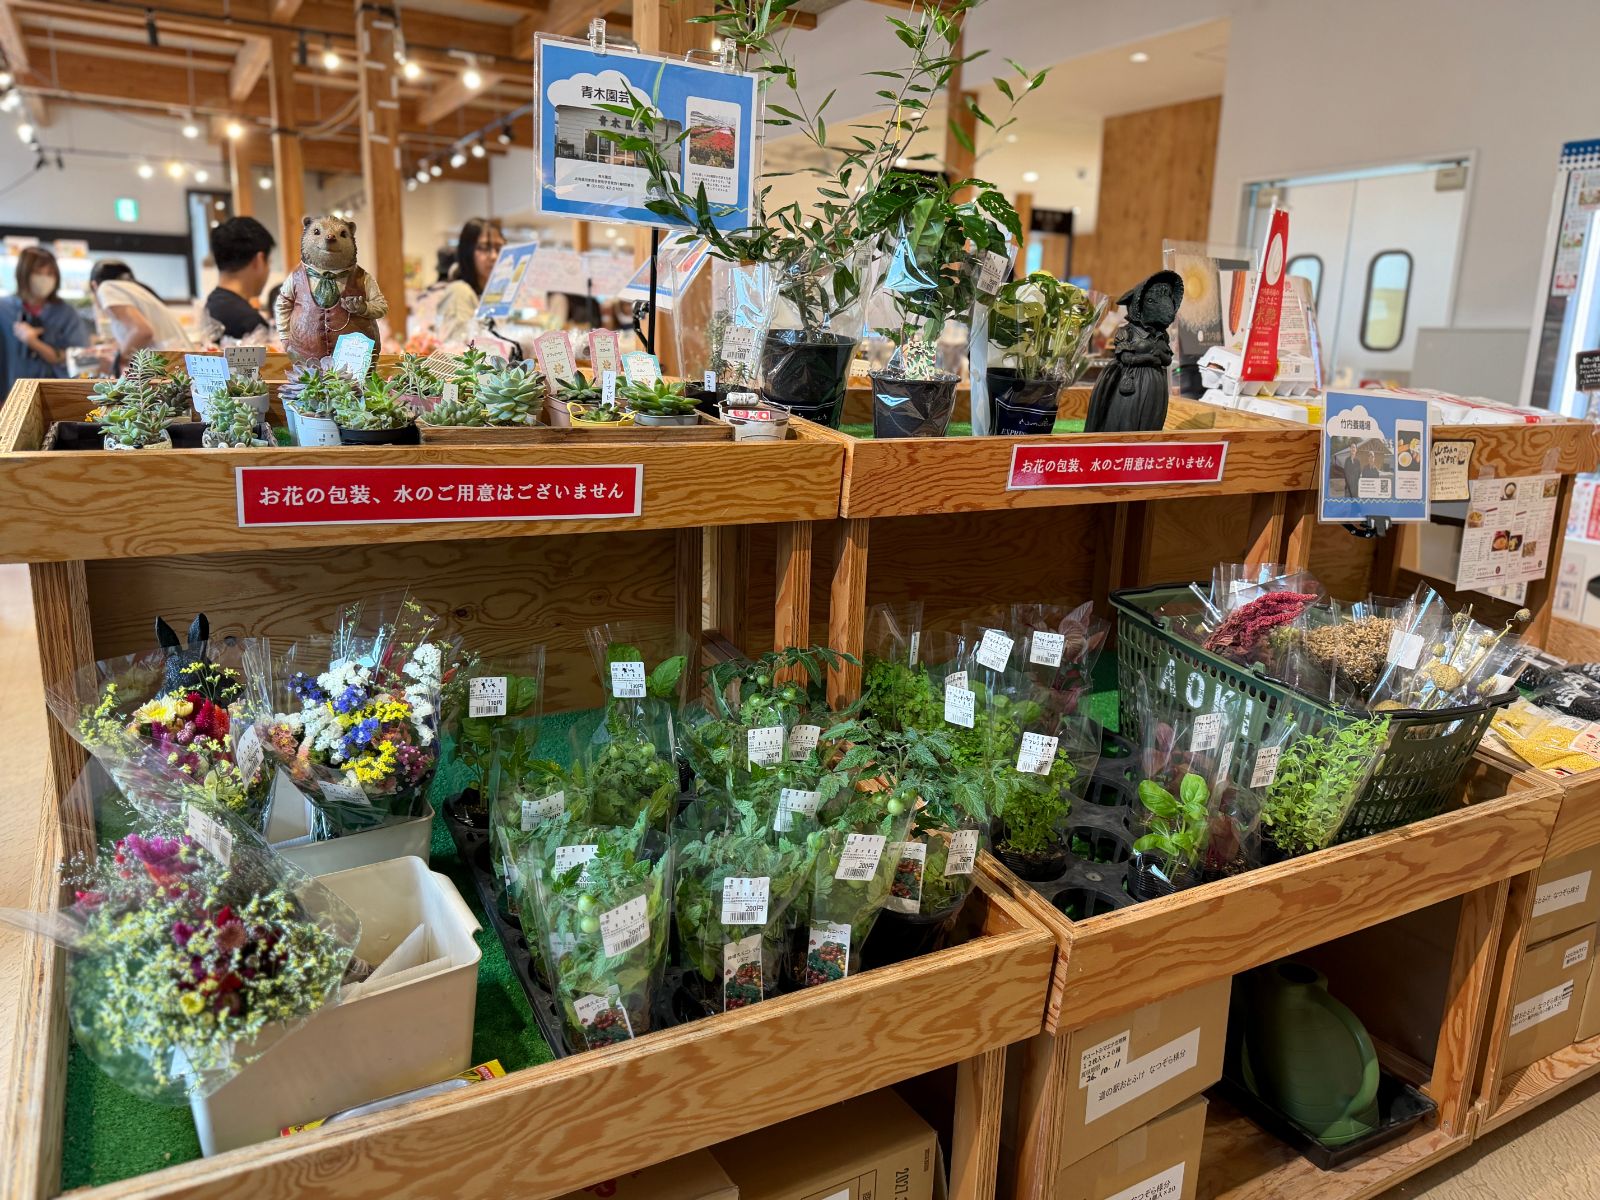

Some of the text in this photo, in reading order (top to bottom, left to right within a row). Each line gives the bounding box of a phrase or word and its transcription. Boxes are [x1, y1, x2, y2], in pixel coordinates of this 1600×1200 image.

[581, 86, 629, 104] 青木園芸
[1021, 456, 1214, 473] お花の包装、水のご用意はございません
[259, 482, 624, 506] お花の包装、水のご用意はございません
[858, 862, 875, 870] 200円
[628, 922, 645, 938] 200円
[1098, 1049, 1186, 1102] 道の駅おとふけ なつぞら様分
